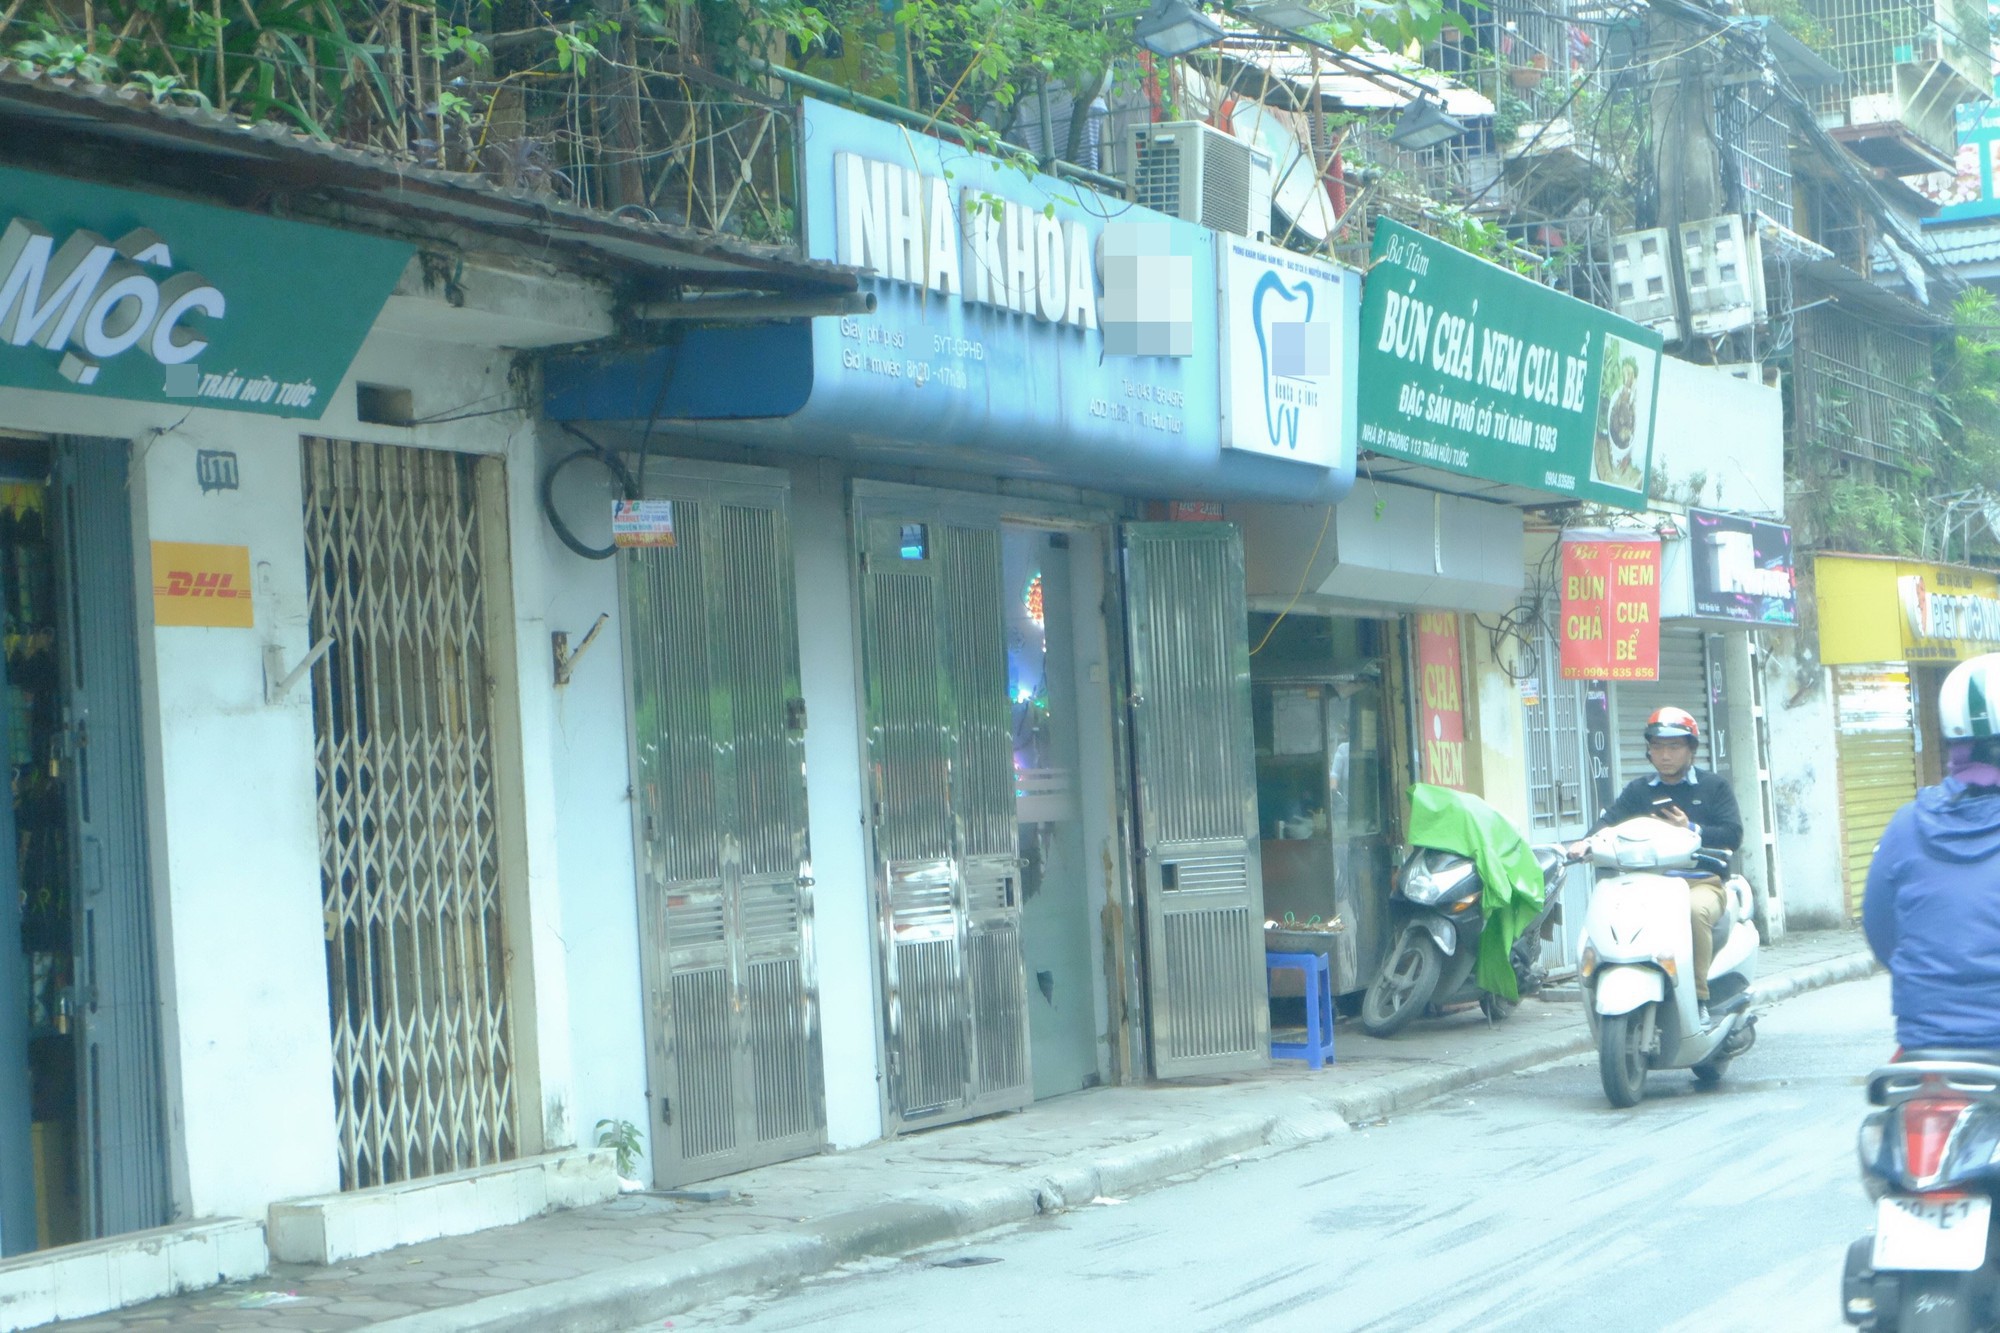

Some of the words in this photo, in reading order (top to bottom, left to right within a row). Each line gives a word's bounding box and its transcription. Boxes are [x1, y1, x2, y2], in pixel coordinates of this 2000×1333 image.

[835, 152, 961, 296] NHA
[961, 187, 1097, 330] KHOA
[1386, 233, 1404, 266] Bà
[1405, 241, 1430, 277] Tâm
[0, 222, 226, 385] MỘC
[1378, 279, 1433, 365] BÚN
[1432, 299, 1478, 382] CHẢ
[1477, 328, 1523, 395] NEM
[1523, 344, 1559, 407] CUA
[1562, 330, 1591, 414] BỂ
[1398, 382, 1425, 421] ĐẶC
[1425, 384, 1451, 426] SẢN
[1451, 397, 1478, 433] PHỐ
[1476, 401, 1495, 437] CỔ
[1493, 409, 1509, 441] TỪ
[1507, 415, 1533, 447] NĂM
[1534, 424, 1558, 453] 1993
[1569, 543, 1598, 560] Bà
[1607, 543, 1652, 560] Tâm
[167, 571, 238, 597] DHL
[1567, 569, 1604, 601] BÚN
[1618, 565, 1654, 586] NEM
[1567, 605, 1602, 641] CHẢ
[1616, 601, 1650, 623] CUA
[1931, 592, 1958, 640] PET
[1616, 628, 1640, 661] BỂ
[1424, 647, 1460, 712] CHẢ
[1565, 668, 1581, 677] ĐT:
[1583, 668, 1609, 677] 0904
[1612, 668, 1632, 677] 835
[1634, 668, 1655, 677] 856
[1427, 739, 1465, 786] NEM
